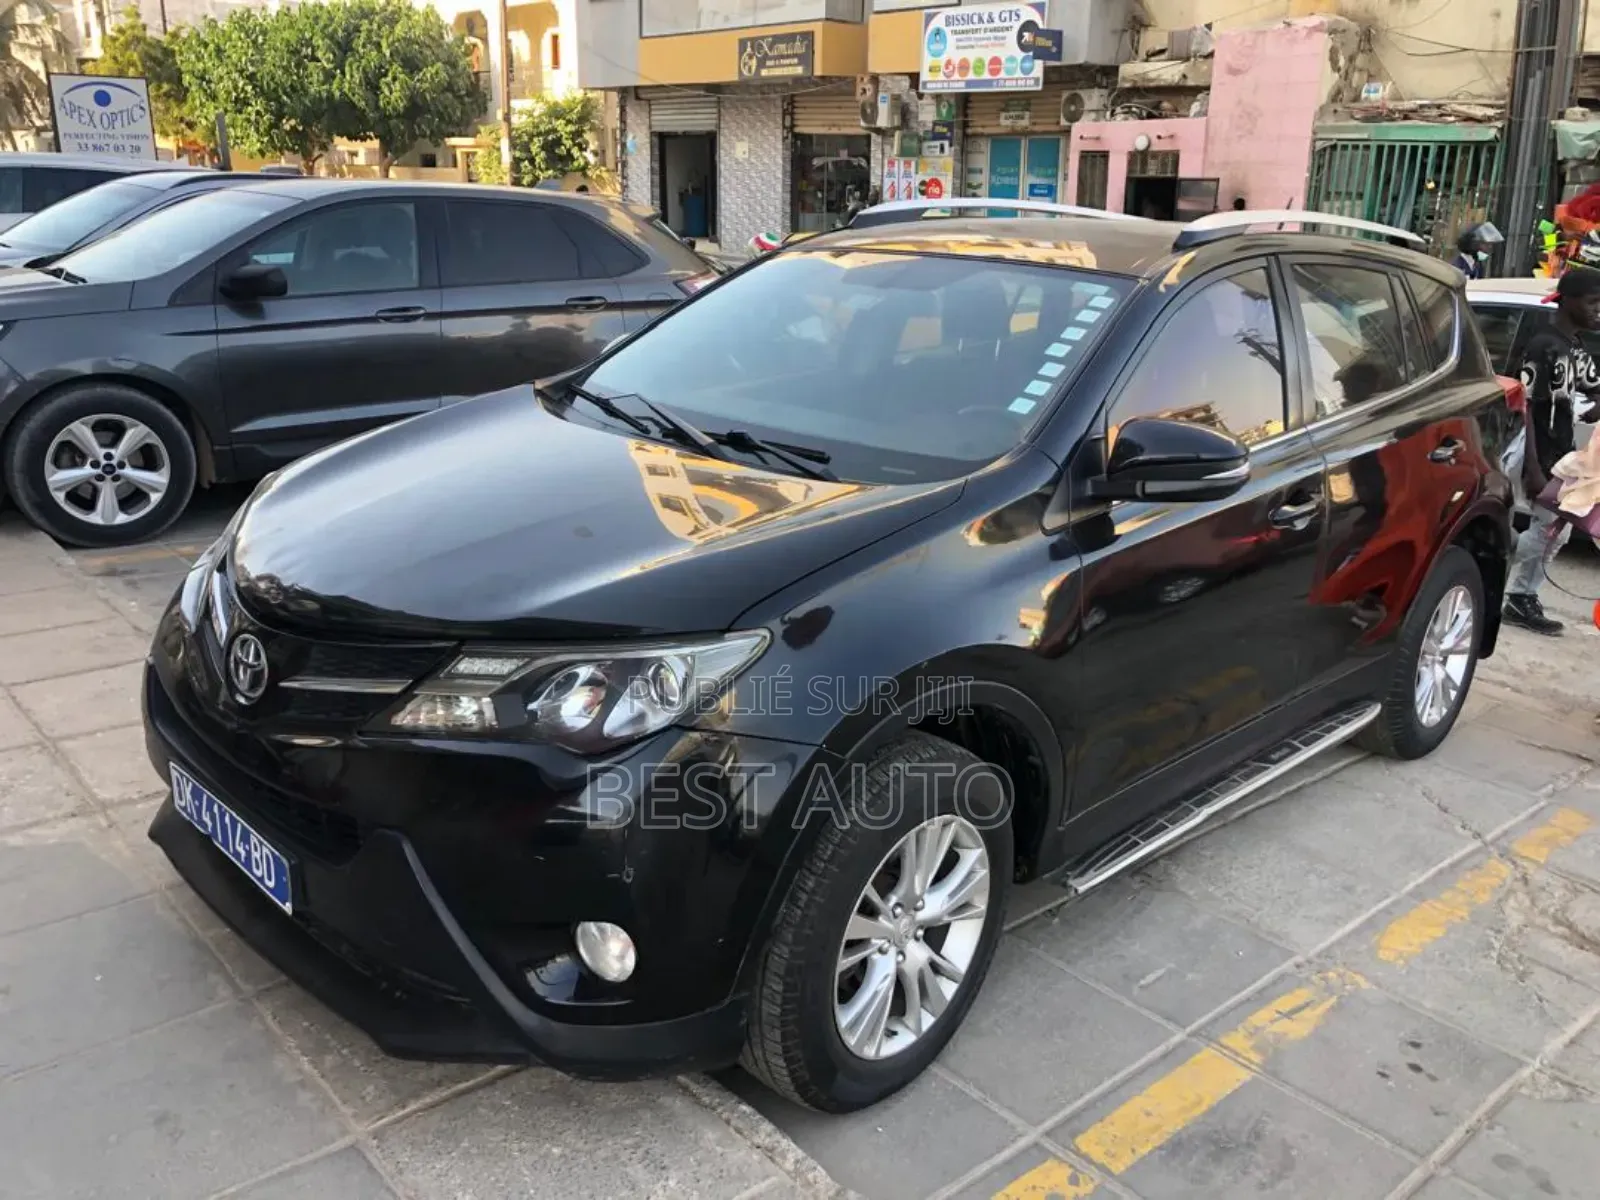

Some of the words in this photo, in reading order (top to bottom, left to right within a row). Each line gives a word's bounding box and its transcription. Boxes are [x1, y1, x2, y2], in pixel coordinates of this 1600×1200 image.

[945, 12, 985, 27] BISSICK
[986, 11, 995, 23] &
[998, 9, 1021, 23] GTS
[58, 96, 97, 129] APEX
[100, 99, 146, 130] OPTICS
[77, 141, 89, 152] 33
[113, 143, 126, 153] 03
